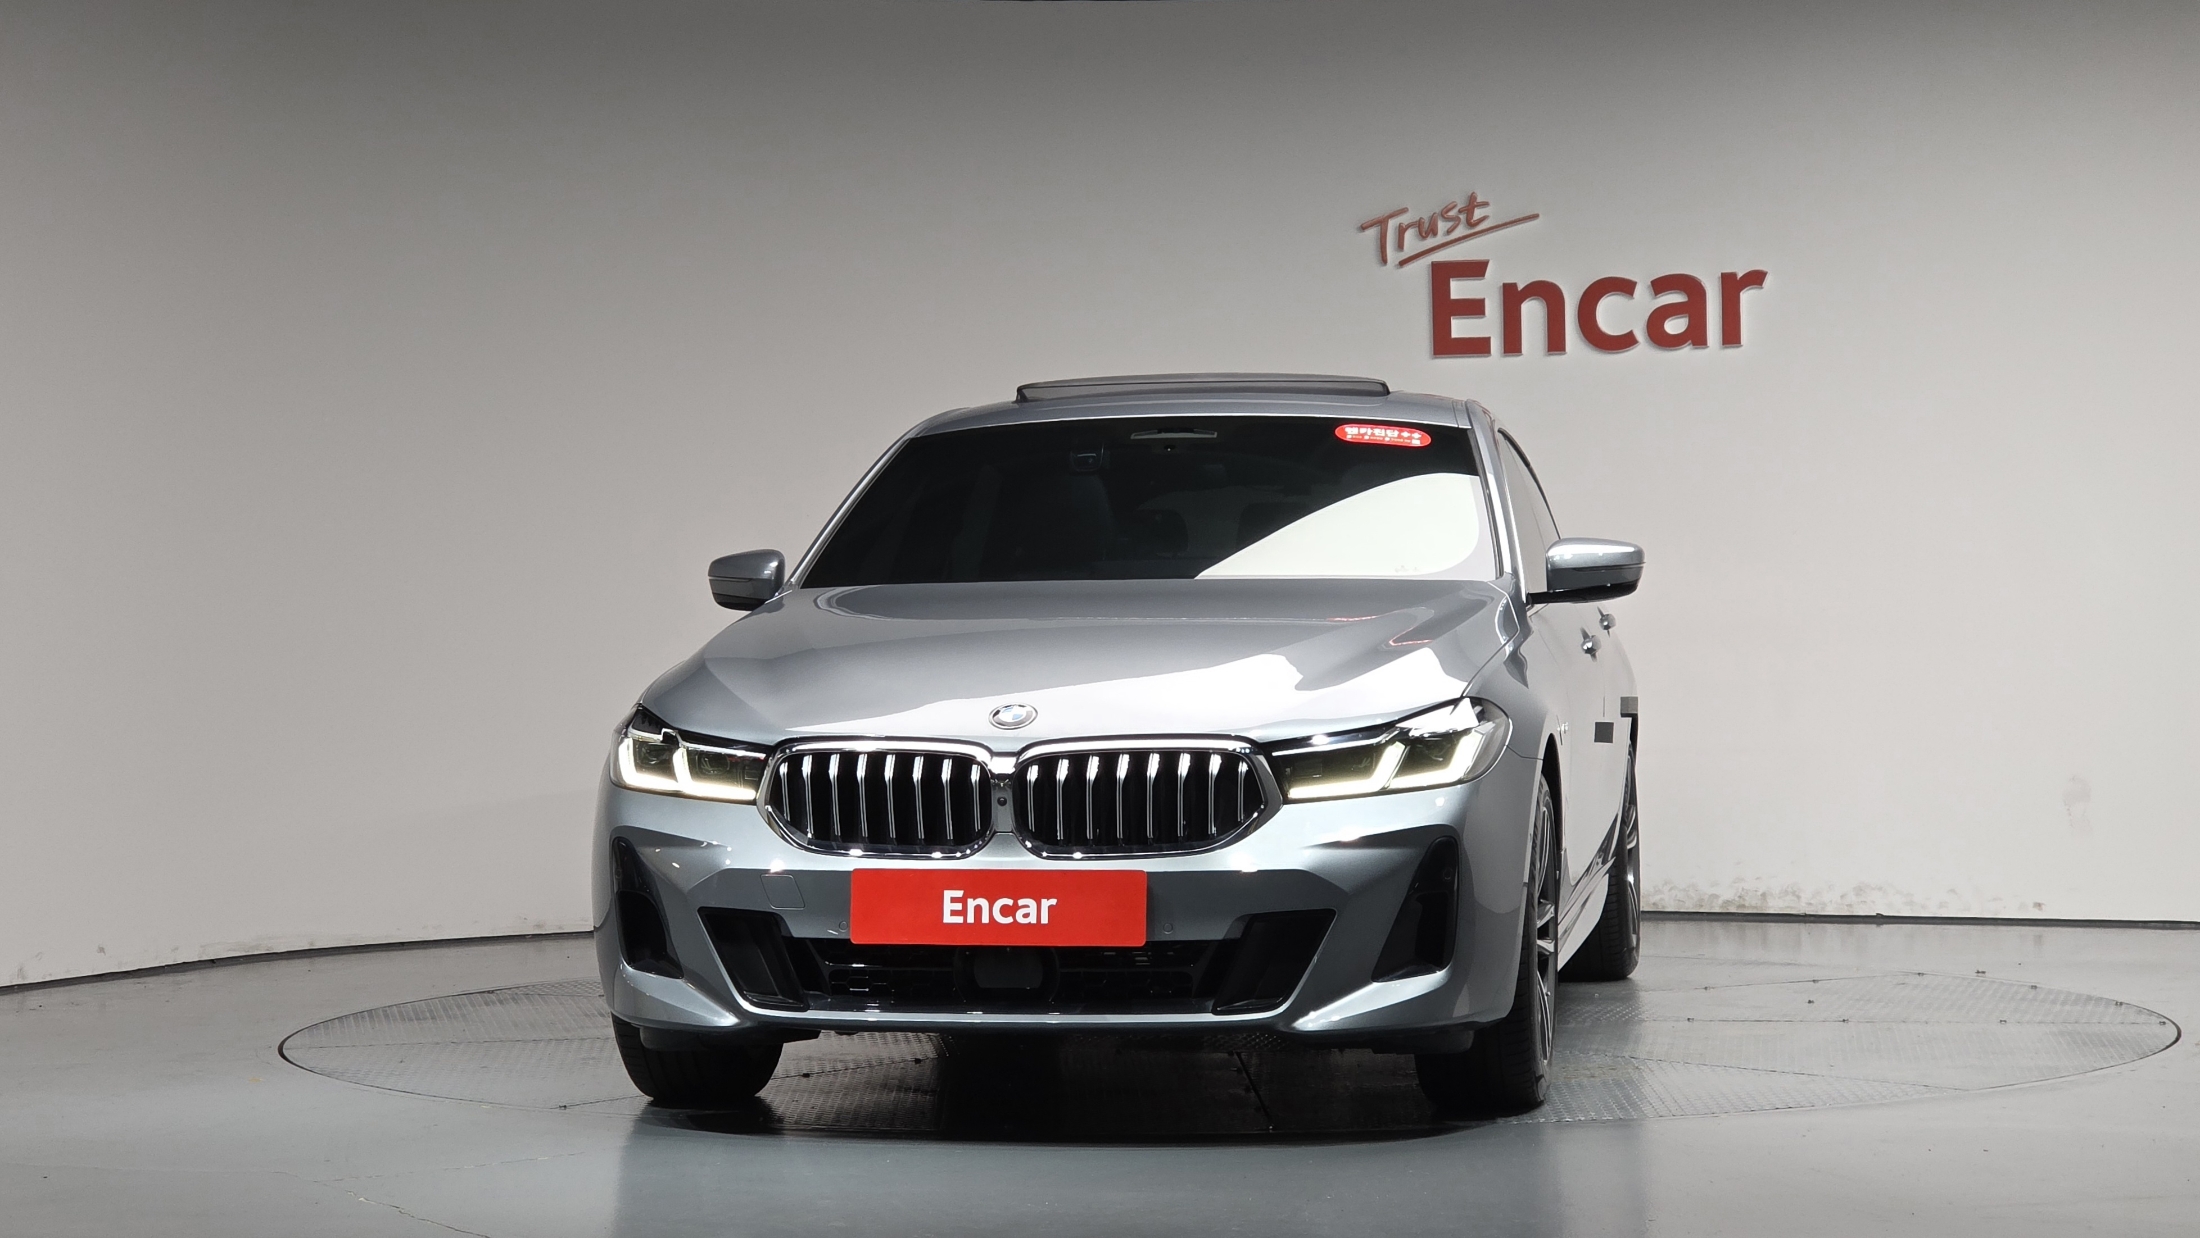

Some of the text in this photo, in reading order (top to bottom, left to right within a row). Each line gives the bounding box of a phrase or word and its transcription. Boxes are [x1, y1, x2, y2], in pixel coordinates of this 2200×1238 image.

[1362, 191, 1491, 264] Trust
[1430, 259, 1768, 357] Encar
[942, 889, 1058, 924] Encar
